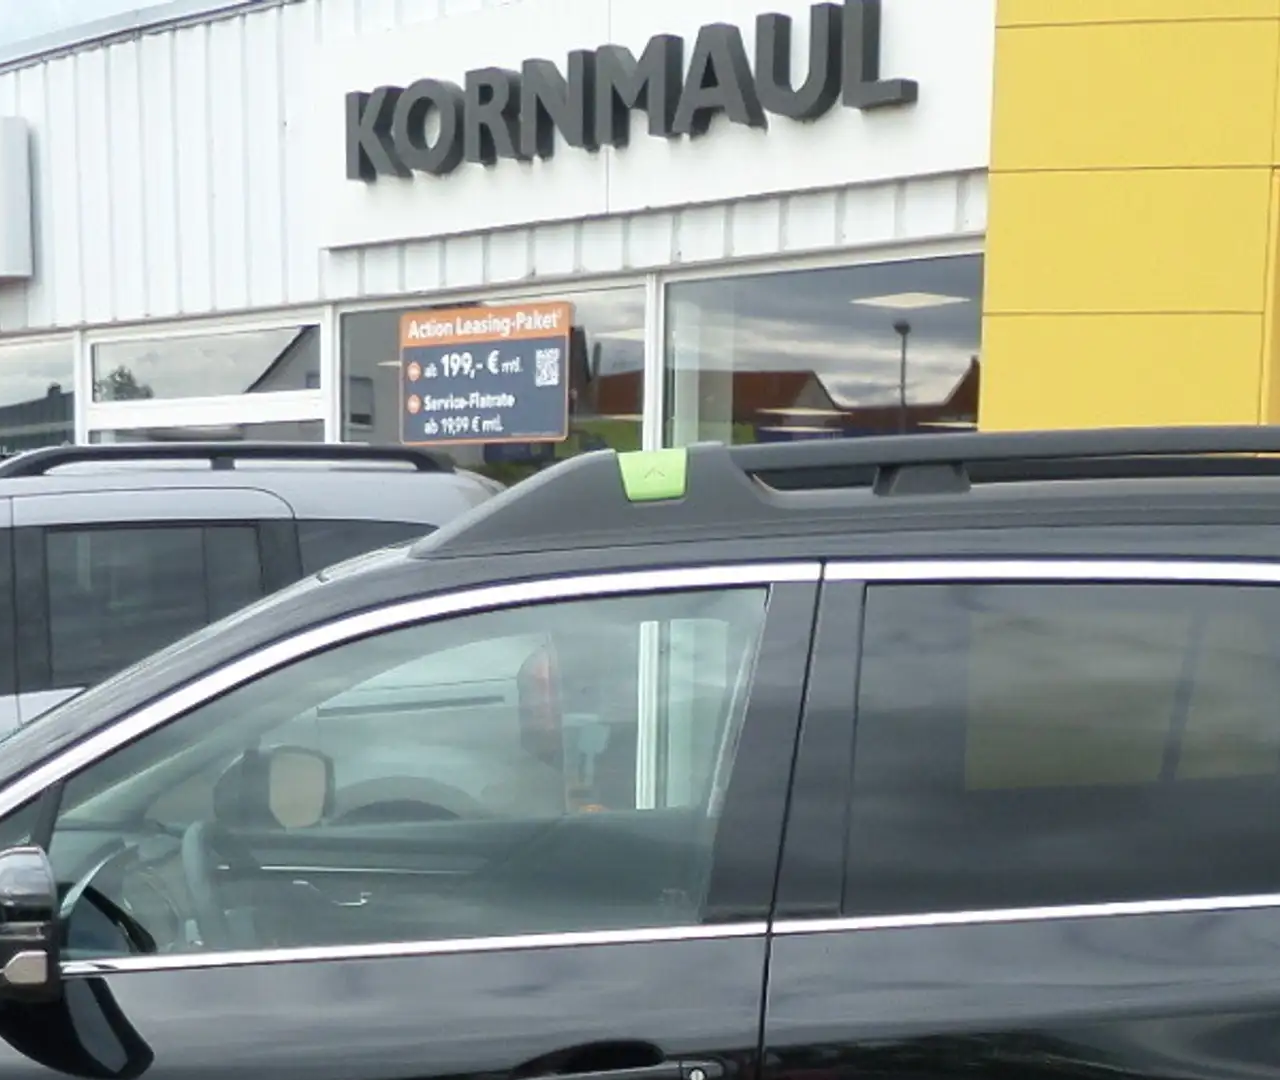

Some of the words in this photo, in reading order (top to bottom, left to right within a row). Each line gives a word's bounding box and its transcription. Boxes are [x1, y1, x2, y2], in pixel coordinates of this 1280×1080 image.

[345, 0, 919, 182] KORNMAUL
[407, 318, 454, 339] Action
[440, 351, 484, 379] 199,-
[486, 350, 501, 375] €
[423, 417, 439, 435] ab
[471, 415, 481, 433] €
